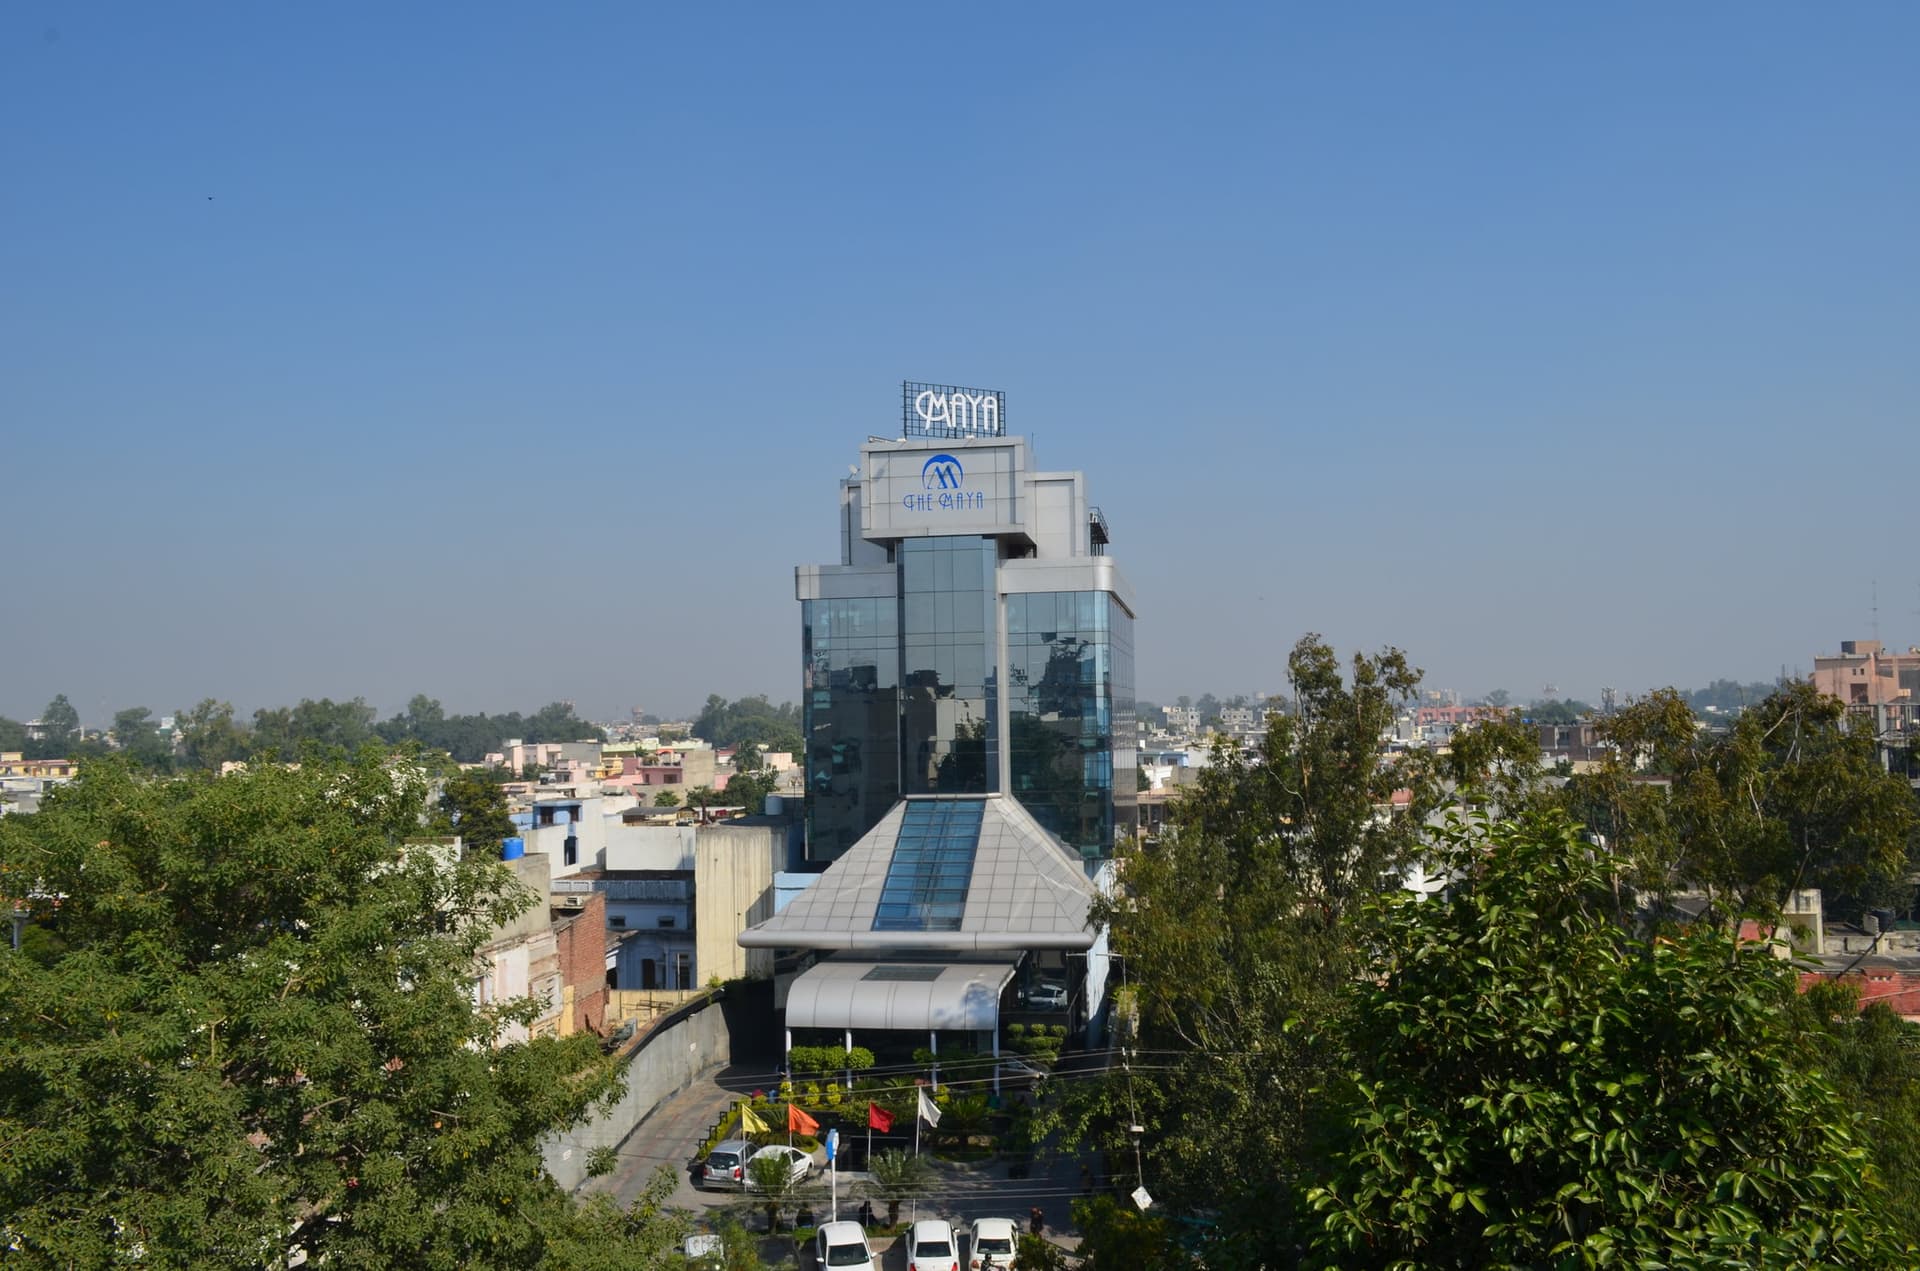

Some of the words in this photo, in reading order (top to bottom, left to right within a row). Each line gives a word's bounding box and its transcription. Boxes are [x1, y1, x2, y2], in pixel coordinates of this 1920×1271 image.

[915, 390, 998, 431] MAYA
[903, 494, 933, 511] THE
[938, 492, 984, 511] MAYA
